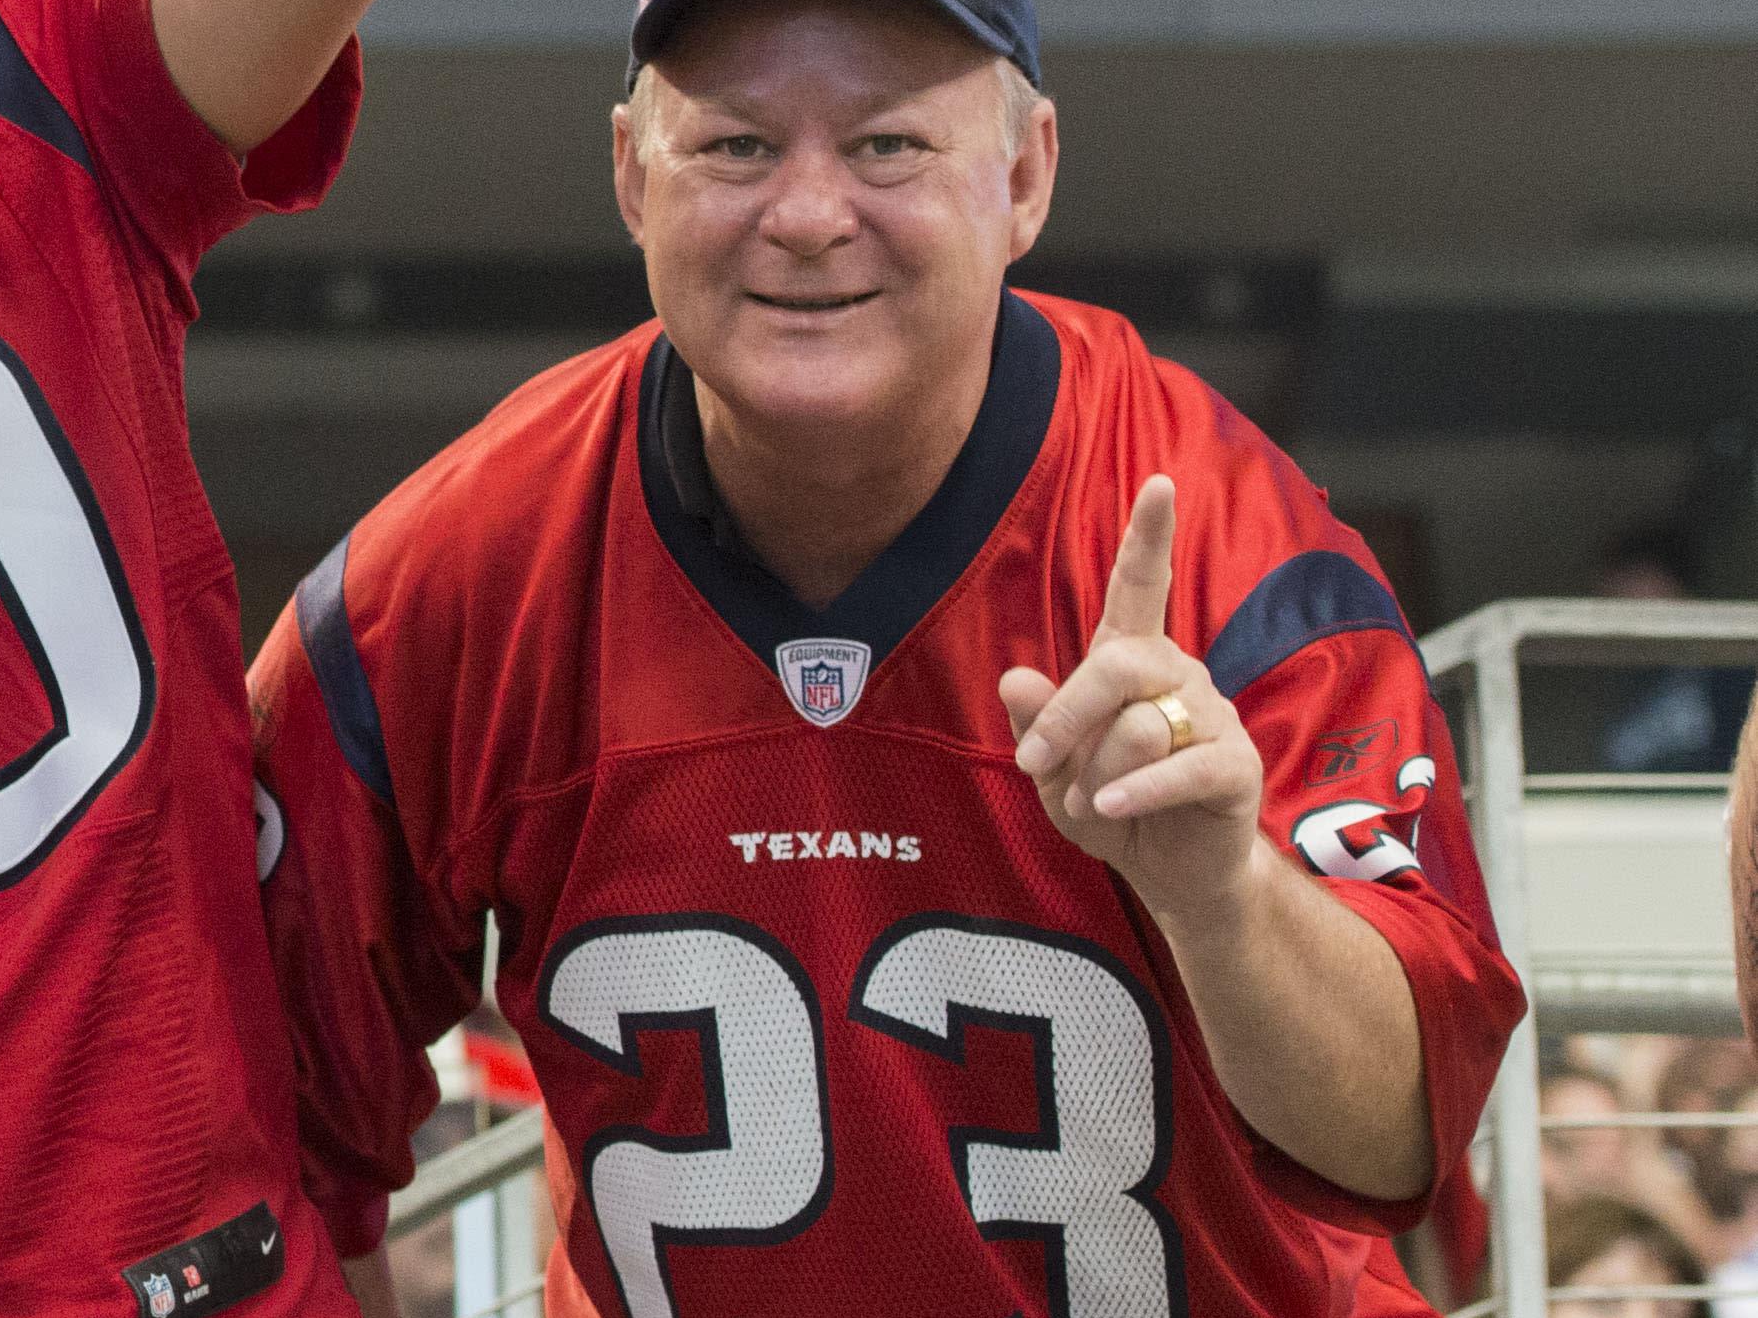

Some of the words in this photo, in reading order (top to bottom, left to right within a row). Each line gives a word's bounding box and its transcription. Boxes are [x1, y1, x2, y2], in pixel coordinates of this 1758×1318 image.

[788, 647, 859, 664] EQUIPMENT
[806, 685, 840, 710] NFL
[729, 831, 922, 864] TEXANS
